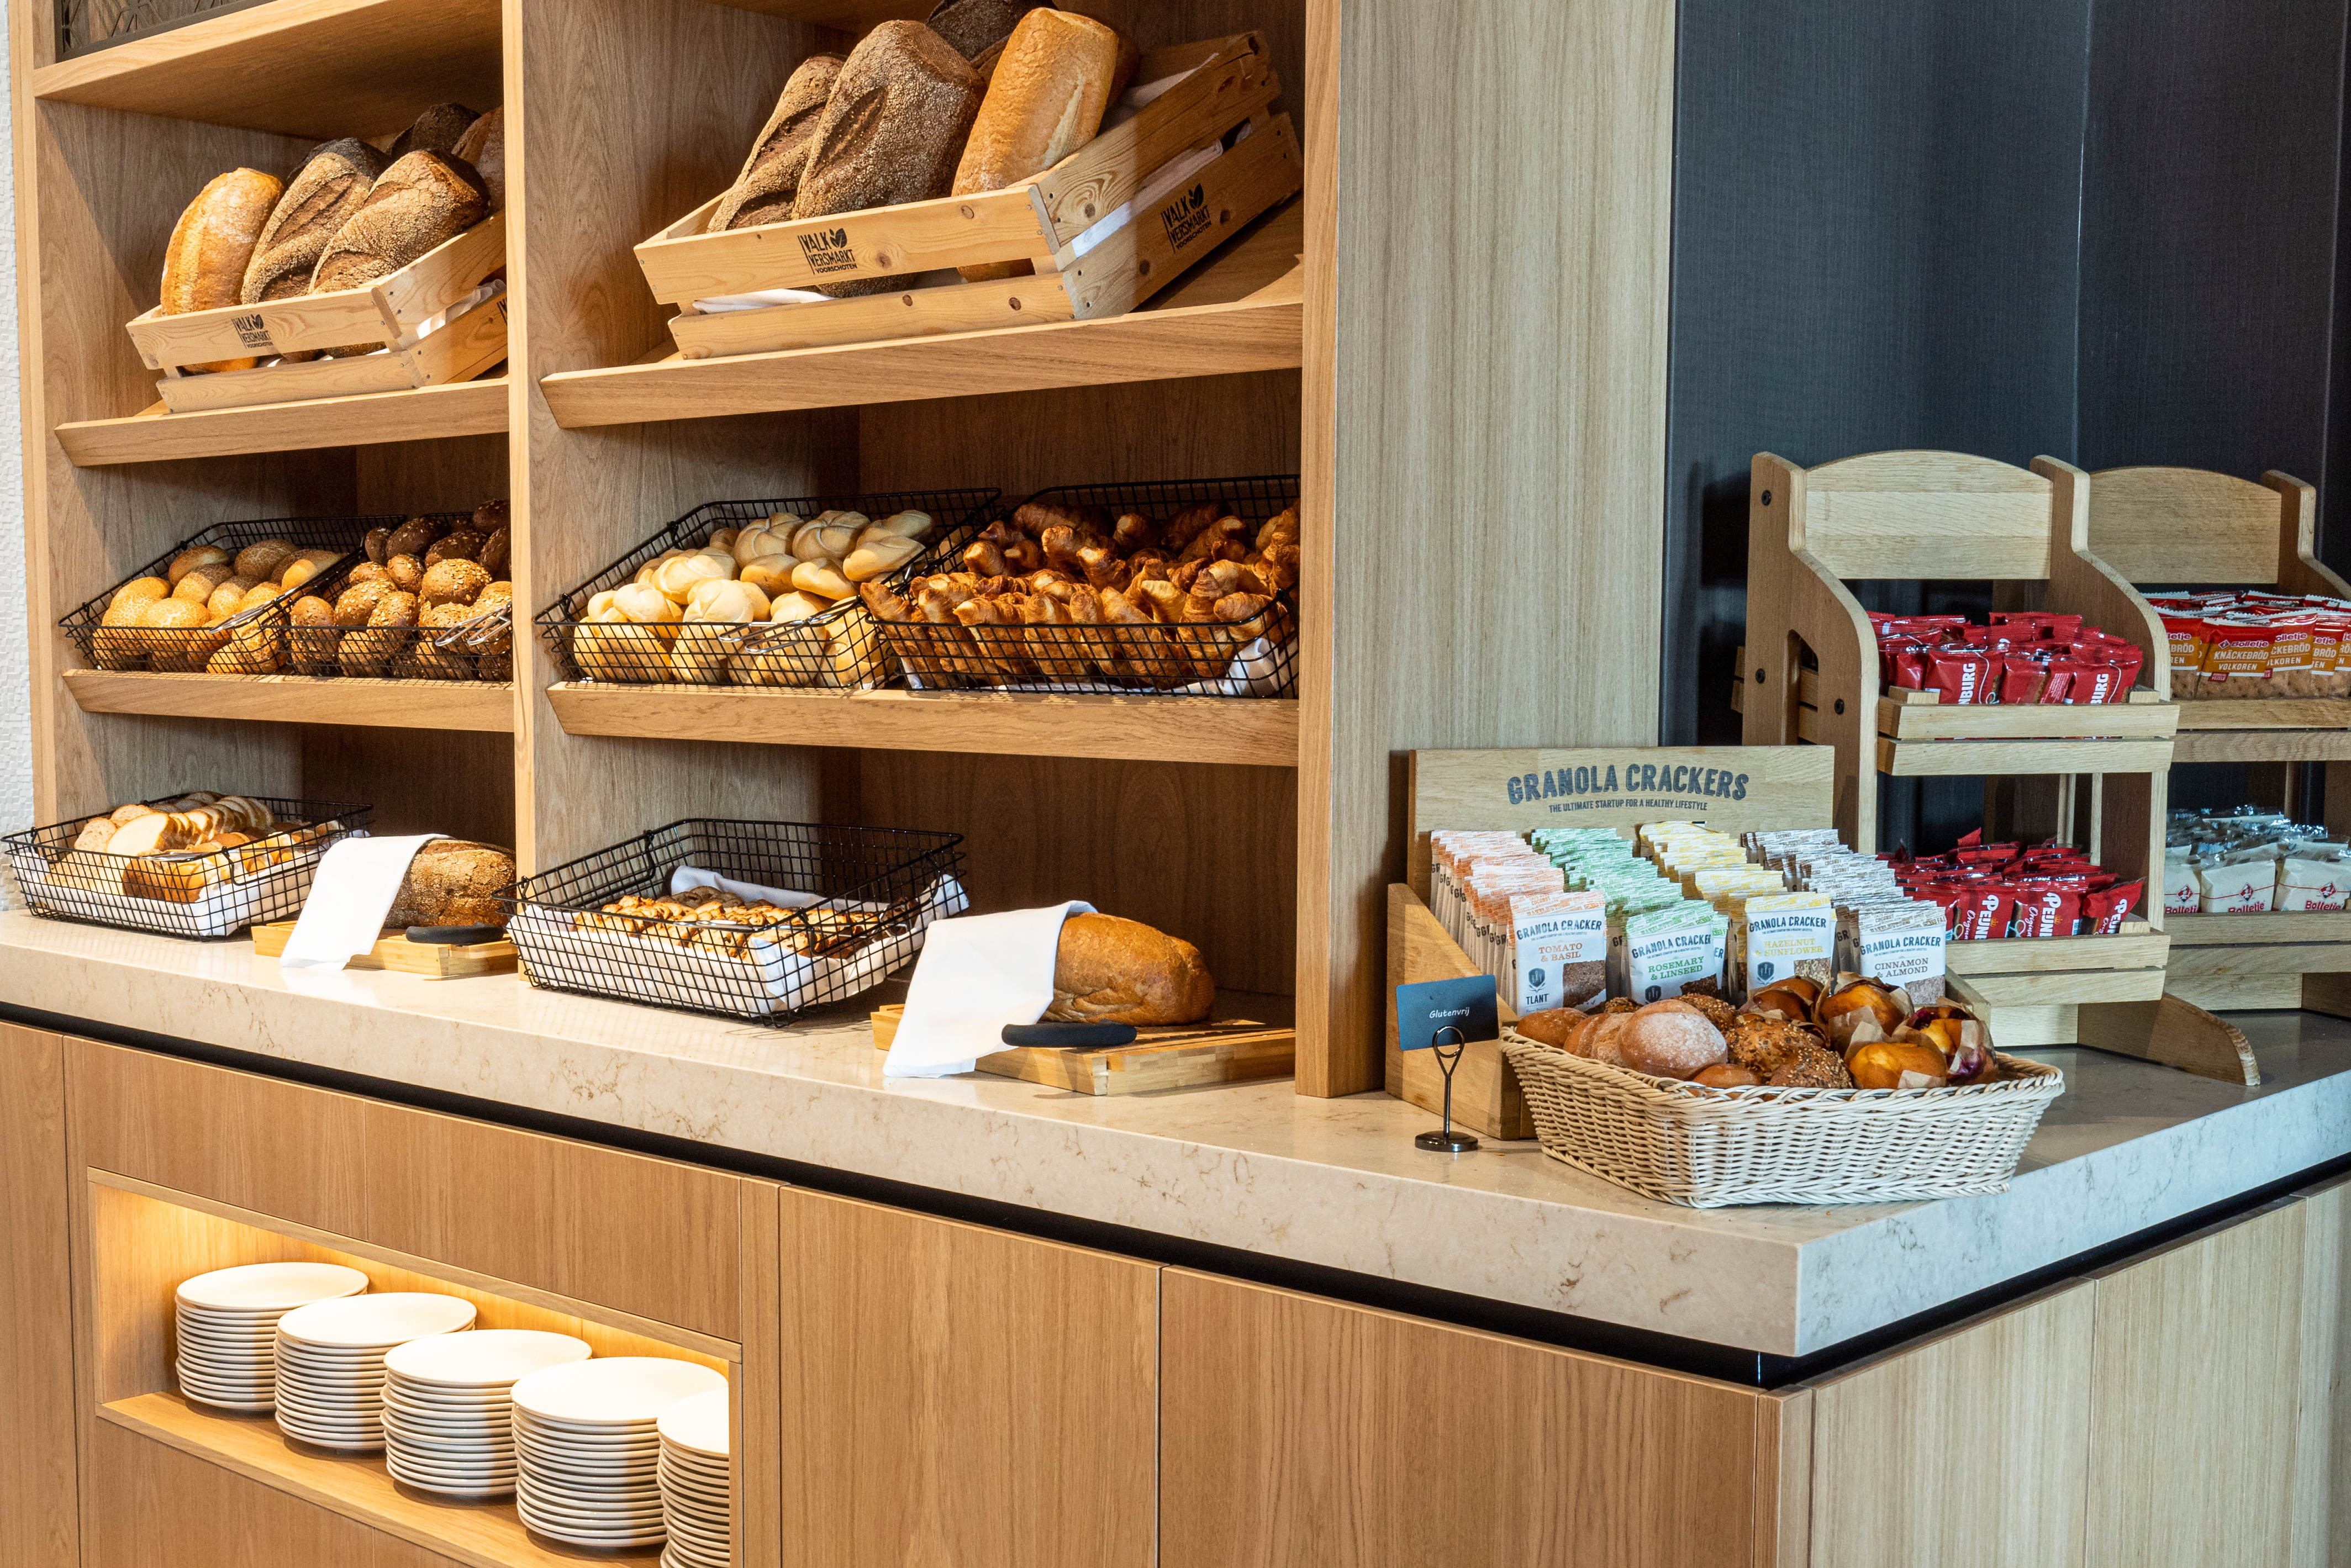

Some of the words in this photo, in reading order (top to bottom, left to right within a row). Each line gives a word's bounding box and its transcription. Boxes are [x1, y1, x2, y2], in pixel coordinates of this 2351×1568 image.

[1163, 196, 1191, 228] VALK
[1170, 205, 1210, 243] VERSMARKT
[1176, 220, 1211, 249] VOORSCHOTEN
[800, 231, 832, 253] VALK
[808, 249, 856, 267] VERSMARKT
[815, 263, 858, 273] VOORSCHOTEN
[233, 316, 255, 332] VALK
[240, 330, 271, 343] VERSMARKT
[2167, 632, 2192, 641] letje
[2275, 632, 2308, 642] olletje
[2230, 640, 2269, 648] Bolletje
[2271, 642, 2311, 655] CKEBRÖD
[2213, 649, 2269, 659] KNÄCKEBRÖD
[2266, 657, 2301, 666] LKOREN
[1507, 764, 1619, 805] GRANOLA
[1625, 764, 1749, 800] CRACKERS
[1549, 804, 1562, 813] THE
[1563, 801, 1594, 811] ULTIMATE
[1595, 799, 1624, 809] STARTUP
[1626, 799, 1638, 807] FOR
[1646, 799, 1674, 807] HEALTHY
[1675, 800, 1708, 811] LIFESTYLE
[1749, 917, 1786, 932] GRANOLA
[1789, 916, 1827, 928] CRACKER
[1963, 910, 1976, 939] Origina
[2024, 906, 2038, 937] Origina
[1517, 921, 1558, 940] GRANOLA
[1561, 919, 1602, 931] CRACKER
[1538, 942, 1583, 954] TOMATO
[1632, 938, 1674, 959] GRANOLA
[1675, 934, 1711, 947] CRACKER
[1764, 938, 1815, 948] HAZELNUT
[1860, 938, 1900, 955] GRANOLA
[1903, 936, 1941, 947] CRACKER
[1551, 951, 1581, 962] BASIL
[1764, 946, 1823, 957] SUNFLOWER
[1648, 955, 1704, 973] ROSEMARY
[1874, 957, 1928, 970] CINNAMON
[1660, 964, 1703, 979] LINSEED
[1885, 966, 1928, 978] ALMOND
[1526, 993, 1549, 1005] TLANT
[1429, 1007, 1470, 1018] Glutenvrij
